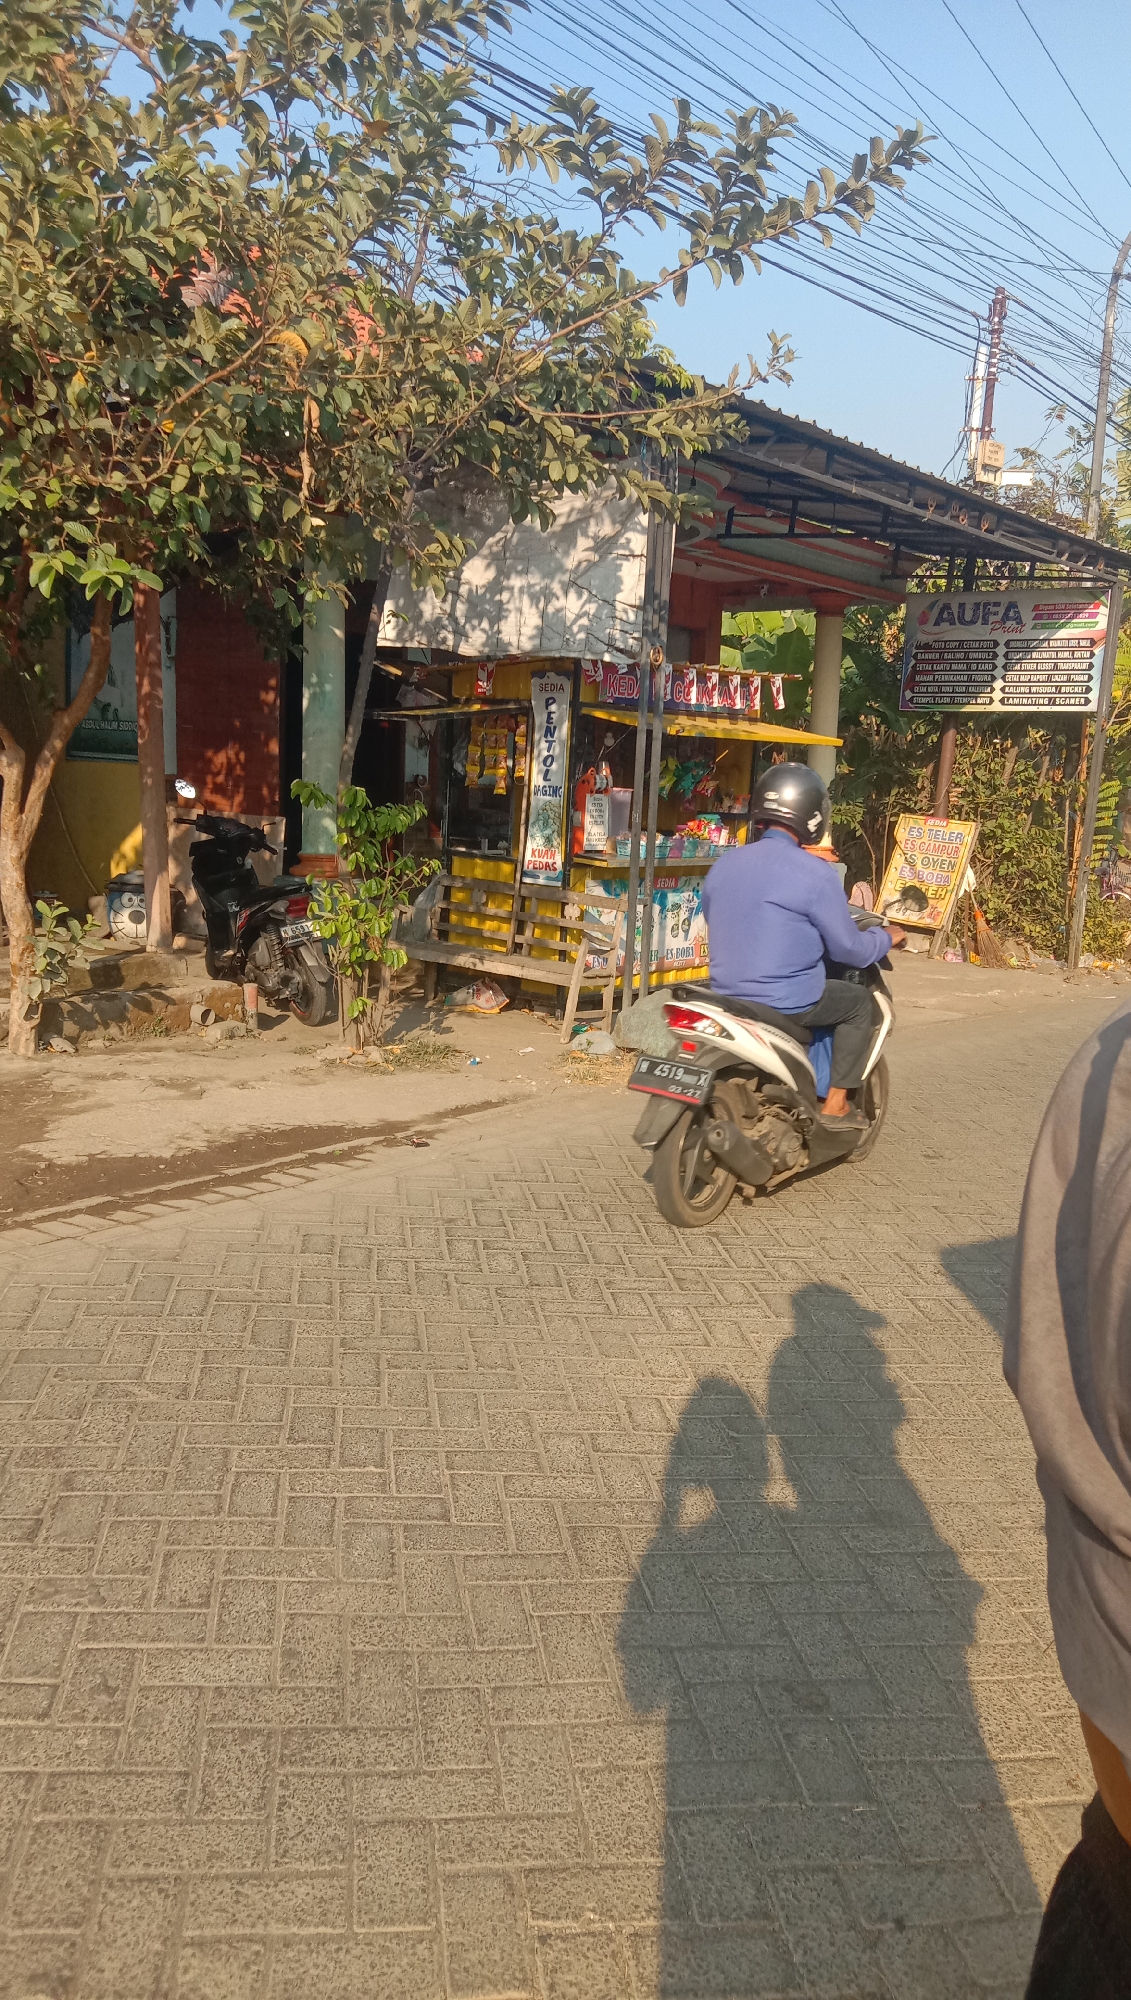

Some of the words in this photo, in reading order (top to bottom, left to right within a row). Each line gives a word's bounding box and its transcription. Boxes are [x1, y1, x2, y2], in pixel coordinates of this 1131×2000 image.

[933, 601, 1023, 626] AUFA
[989, 620, 1027, 635] Print
[538, 683, 565, 692] SEDIA
[82, 720, 100, 729] ABDUL
[100, 720, 118, 730] HALIM
[542, 696, 557, 782] PENTOL
[534, 784, 562, 798] DAGING
[926, 819, 947, 827] SEDIA
[907, 826, 924, 838] ES
[927, 828, 964, 843] TELER
[531, 848, 556, 860] KUAH
[903, 839, 916, 850] ES
[918, 842, 960, 858] CAMPUR
[526, 860, 558, 872] PEDAS
[920, 856, 956, 871] OYEN
[898, 866, 916, 879] ES
[918, 870, 950, 885] BOBA
[656, 878, 676, 888] SEDIA
[666, 948, 674, 960] ES
[676, 946, 694, 959] BOBA
[654, 1064, 684, 1080] 4519
